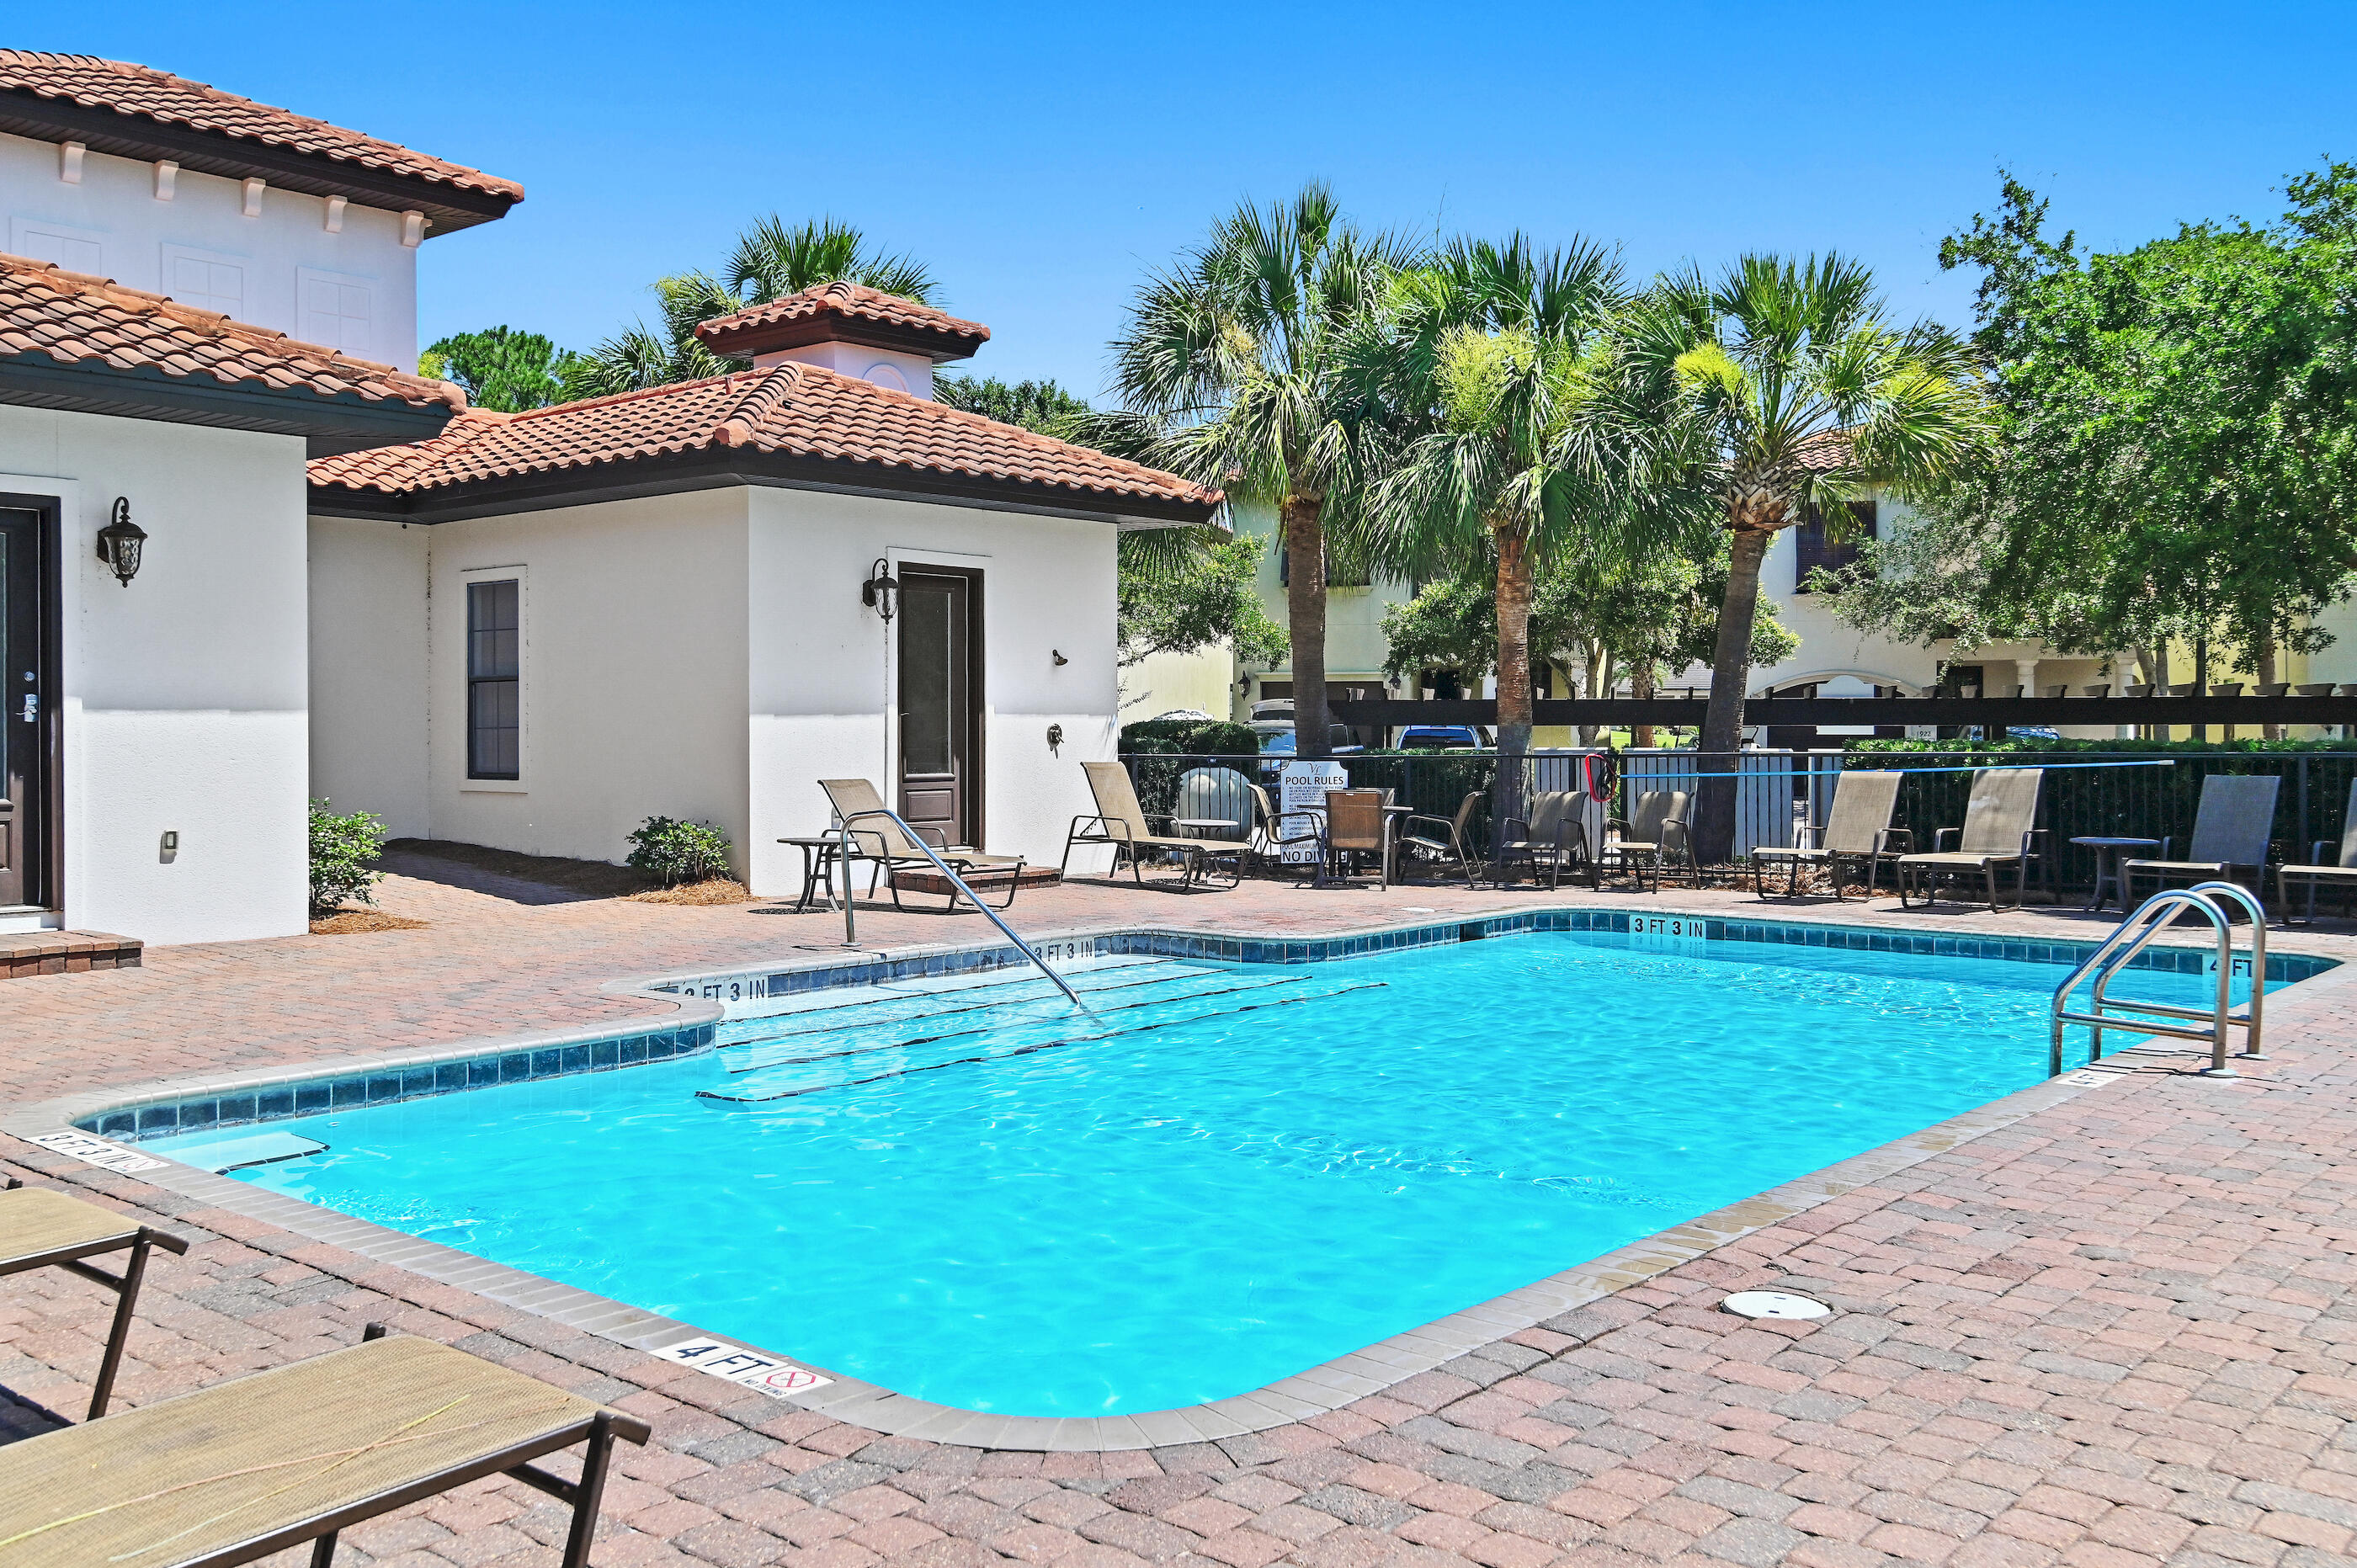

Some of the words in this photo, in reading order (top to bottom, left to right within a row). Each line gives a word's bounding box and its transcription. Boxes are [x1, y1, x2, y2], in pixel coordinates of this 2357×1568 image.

[1285, 776, 1312, 785] POOL
[1314, 776, 1343, 785] RULES
[1283, 851, 1301, 862] NO
[1305, 851, 1346, 863] DIG
[1635, 918, 1643, 933] 3
[1650, 919, 1666, 934] FT
[1672, 921, 1681, 935] 3
[1689, 922, 1702, 937] IN
[1035, 946, 1042, 959] 3
[1048, 943, 1061, 961] FT
[1067, 943, 1074, 959] 3
[1081, 940, 1093, 958] IN
[2232, 959, 2253, 977] FT
[704, 985, 722, 1000] FT
[730, 982, 740, 1002] 3
[749, 979, 765, 999] IN
[52, 1140, 98, 1150] FT
[92, 1153, 139, 1165] IN
[675, 1346, 721, 1359] 4
[704, 1354, 775, 1375] FT
